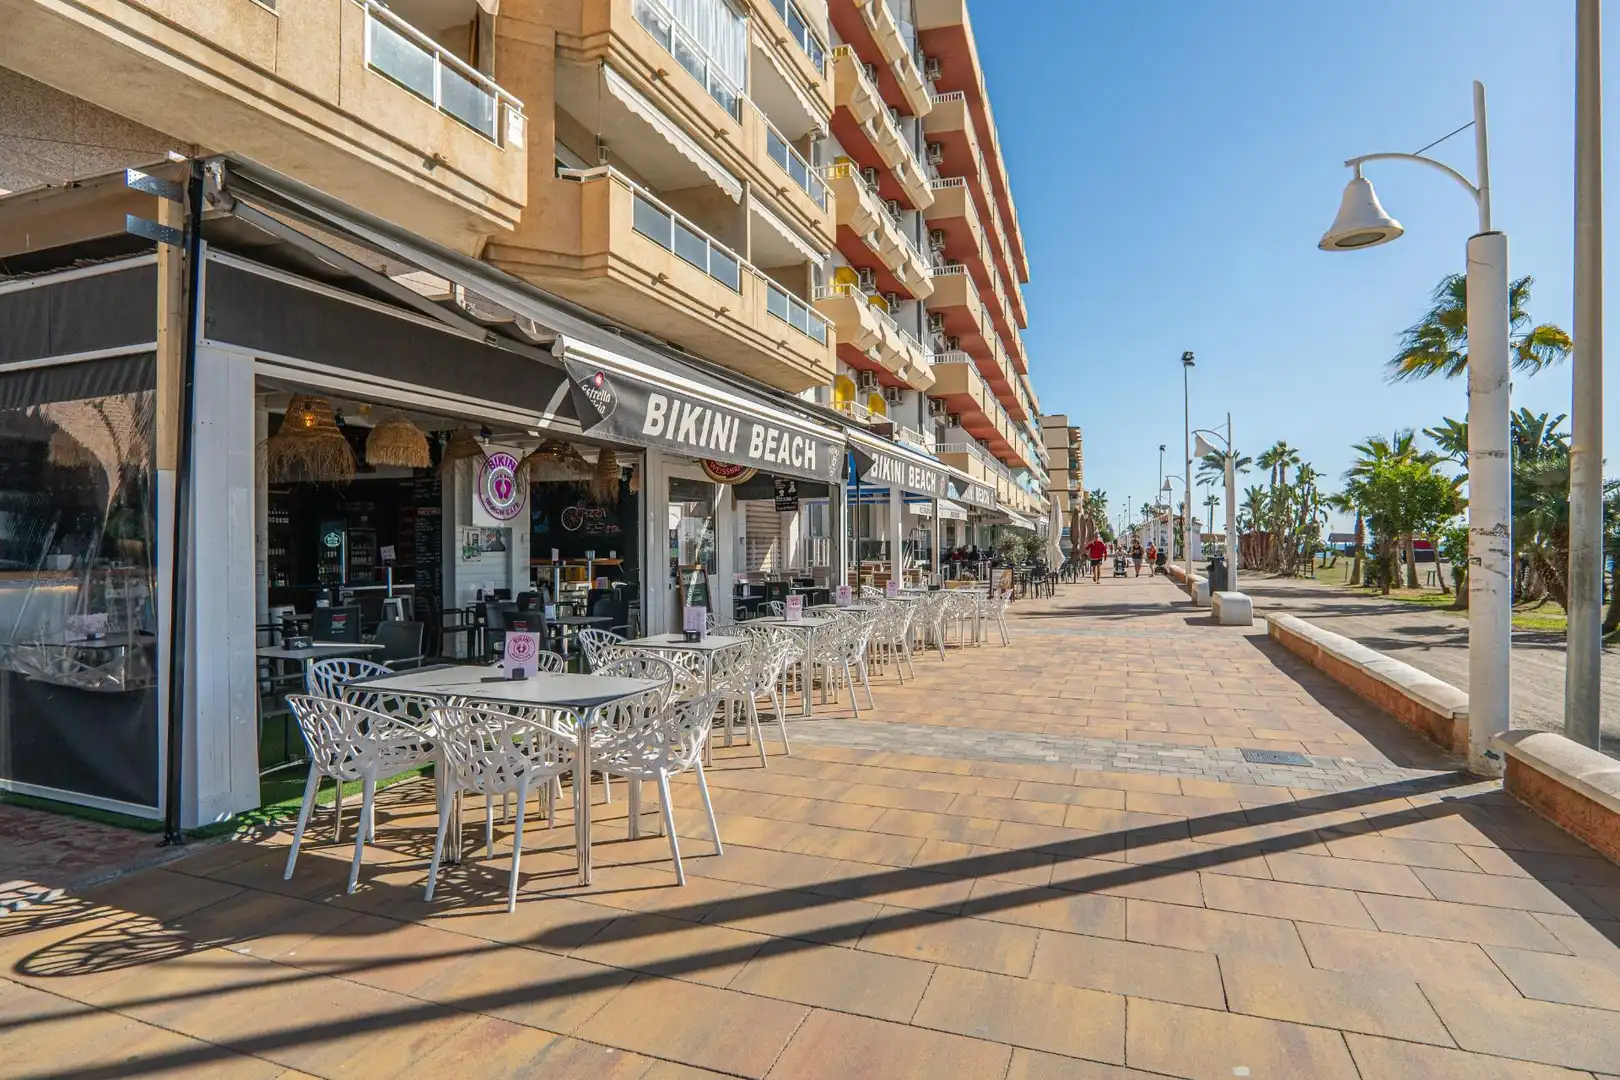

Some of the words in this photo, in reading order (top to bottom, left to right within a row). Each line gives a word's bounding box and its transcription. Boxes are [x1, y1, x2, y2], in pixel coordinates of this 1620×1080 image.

[642, 393, 740, 454] BIKINI
[748, 424, 816, 470] BEACH
[709, 461, 741, 475] WEISSBR
[870, 452, 905, 485] BIKINI
[908, 464, 937, 493] BEACH
